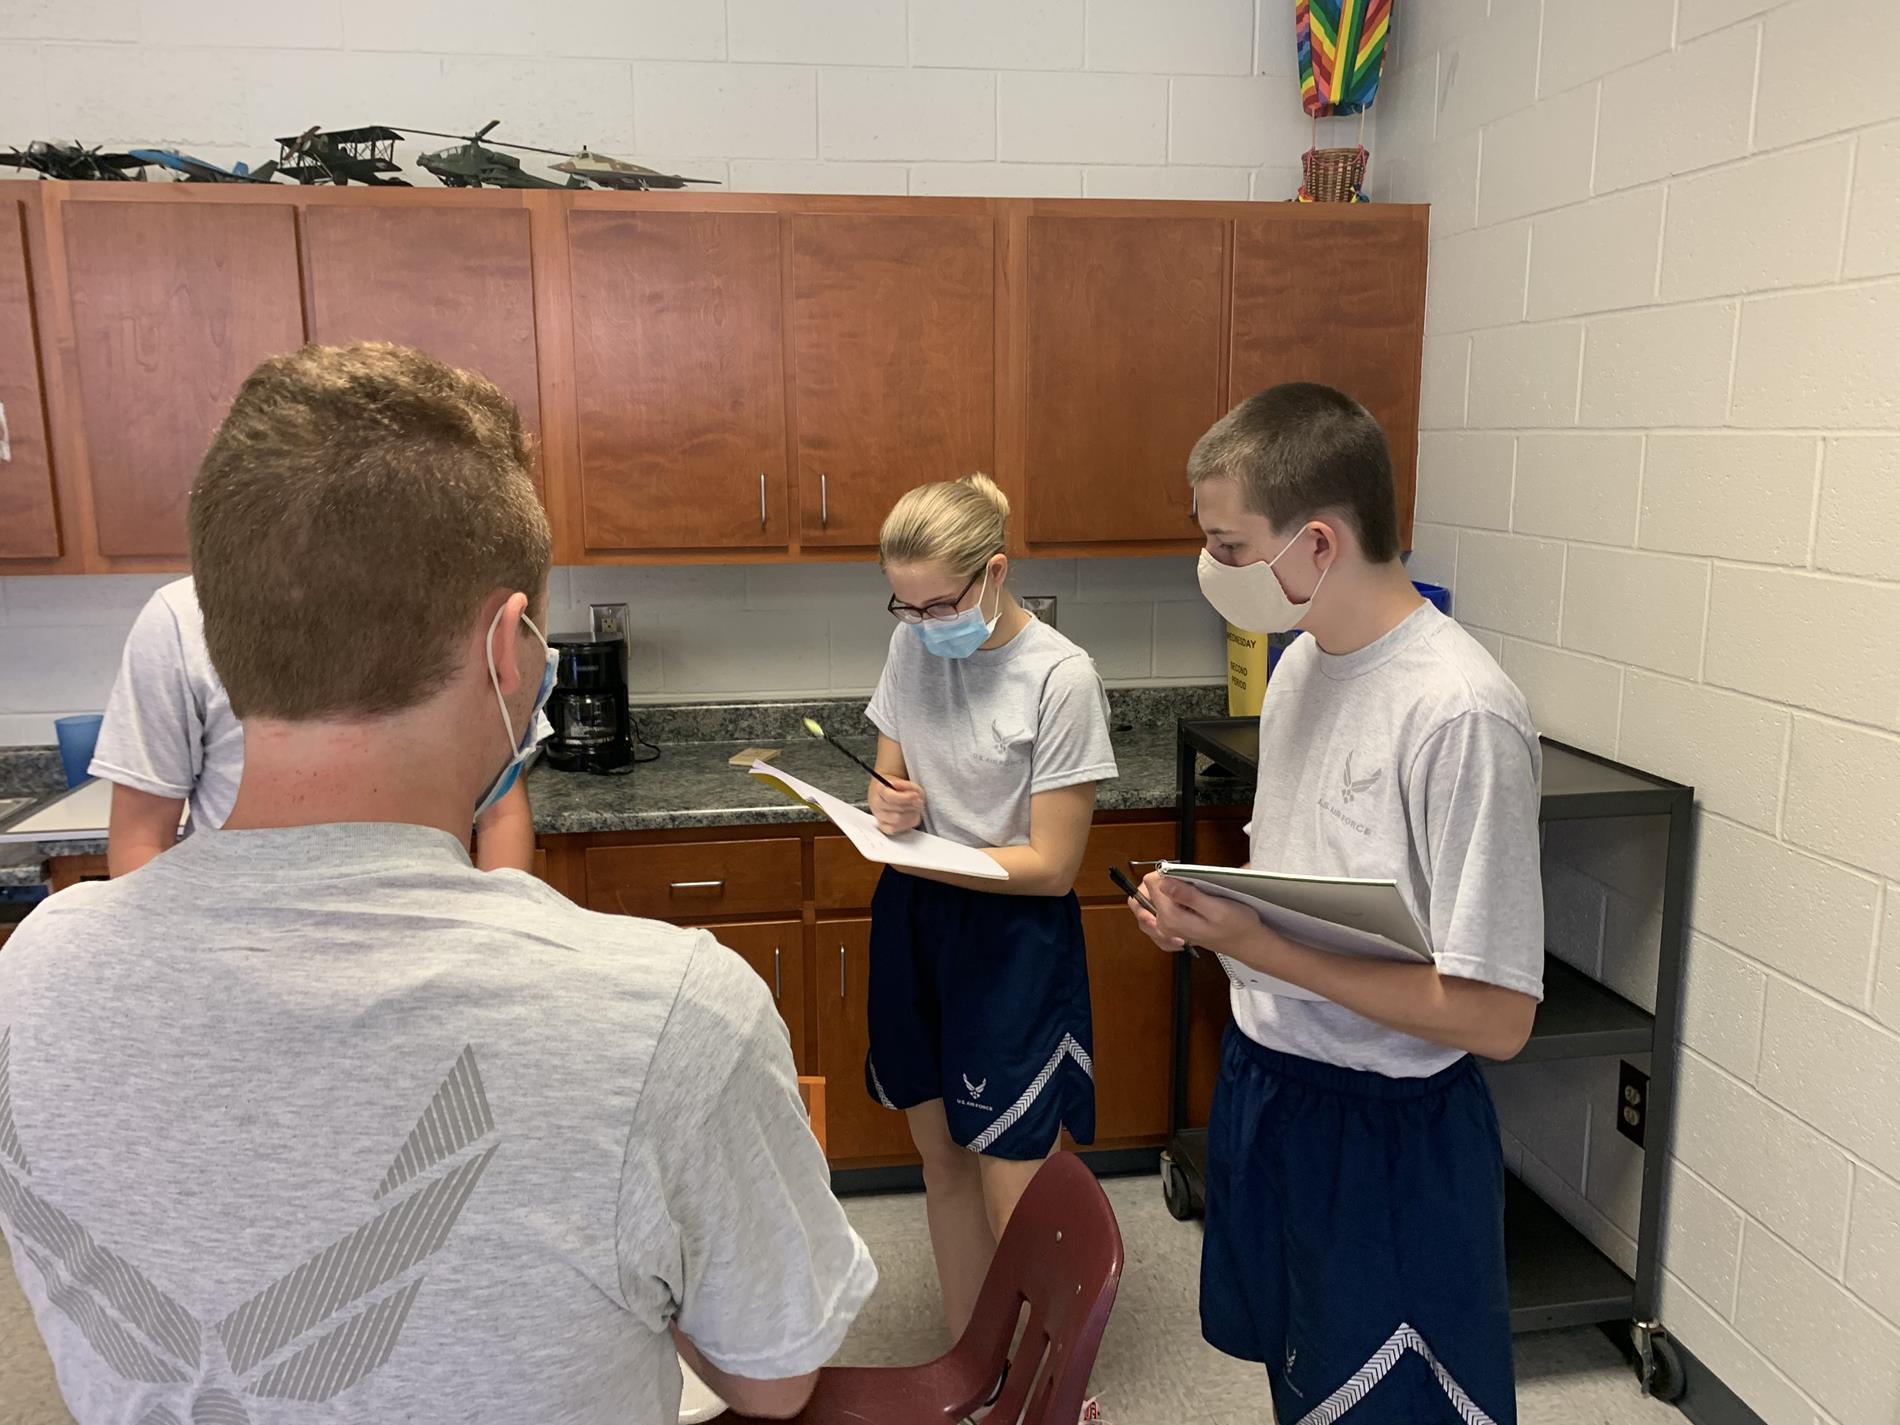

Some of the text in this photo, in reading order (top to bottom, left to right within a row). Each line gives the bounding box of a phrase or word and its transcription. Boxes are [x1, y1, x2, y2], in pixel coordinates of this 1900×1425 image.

[1330, 806, 1341, 819] AIR
[1341, 814, 1372, 836] FORCE
[975, 1103, 993, 1111] FORCE
